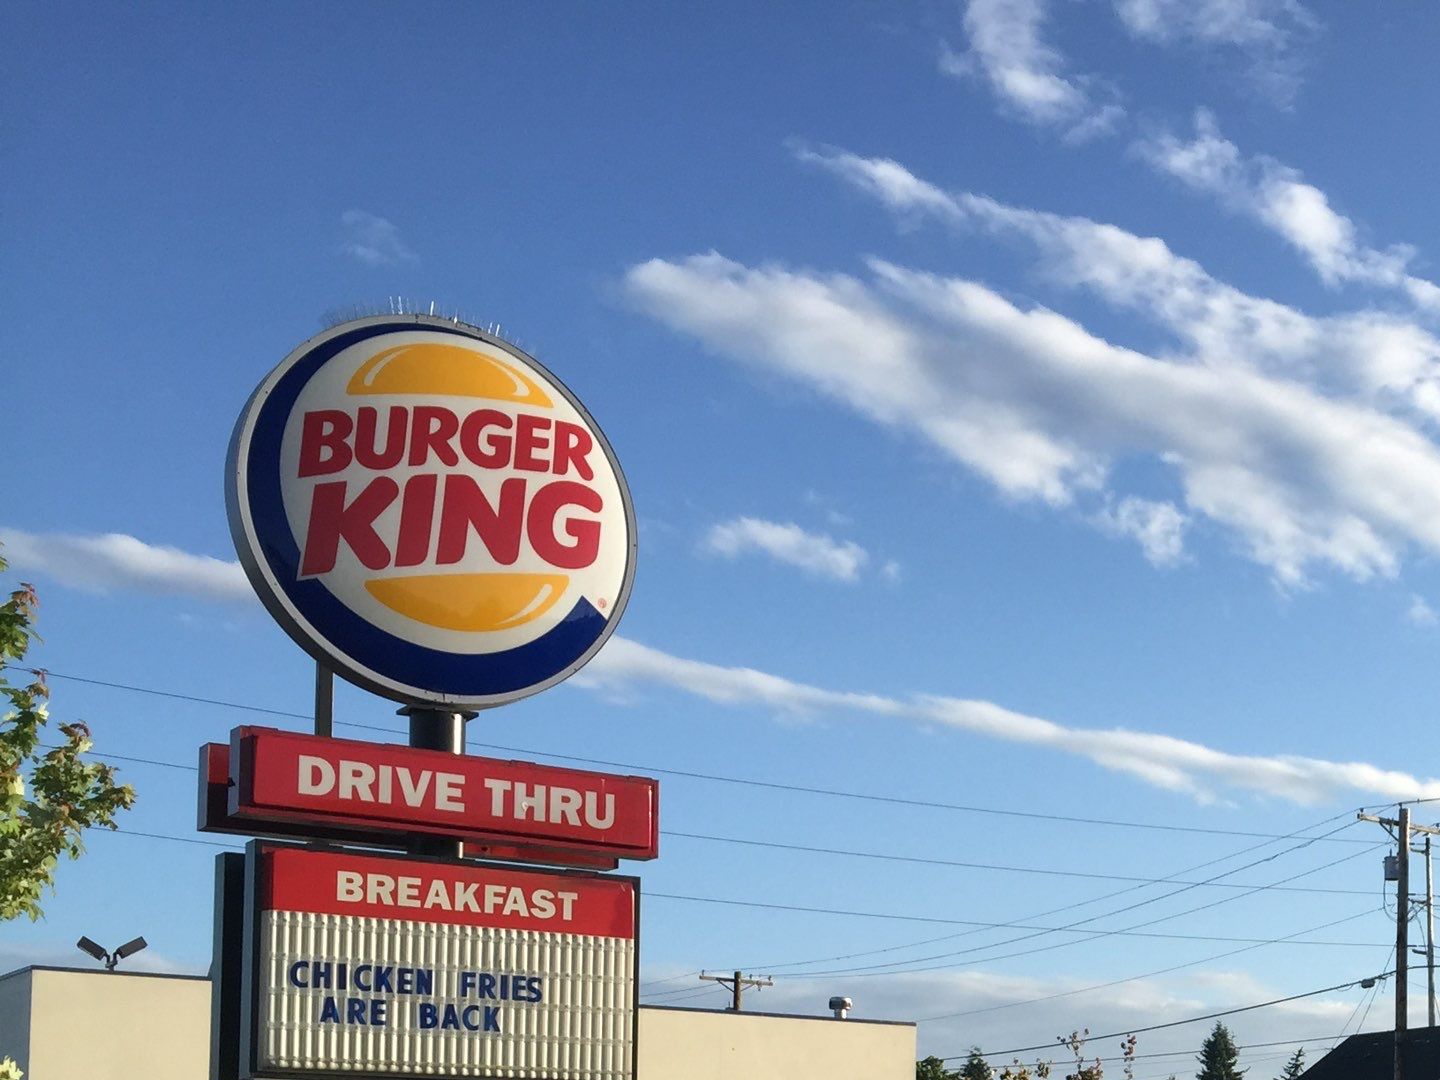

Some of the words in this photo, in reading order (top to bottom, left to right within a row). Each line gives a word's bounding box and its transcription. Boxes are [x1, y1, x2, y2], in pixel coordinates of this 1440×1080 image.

[297, 405, 594, 481] BURGER
[301, 473, 604, 576] KING
[297, 754, 466, 813] DRIVE
[484, 778, 616, 830] THRU
[336, 870, 579, 921] BREAKFAST
[289, 960, 433, 996] CHICKEN
[460, 971, 543, 1003] FRIES
[319, 996, 387, 1026] ARE
[419, 1004, 502, 1033] BACK
